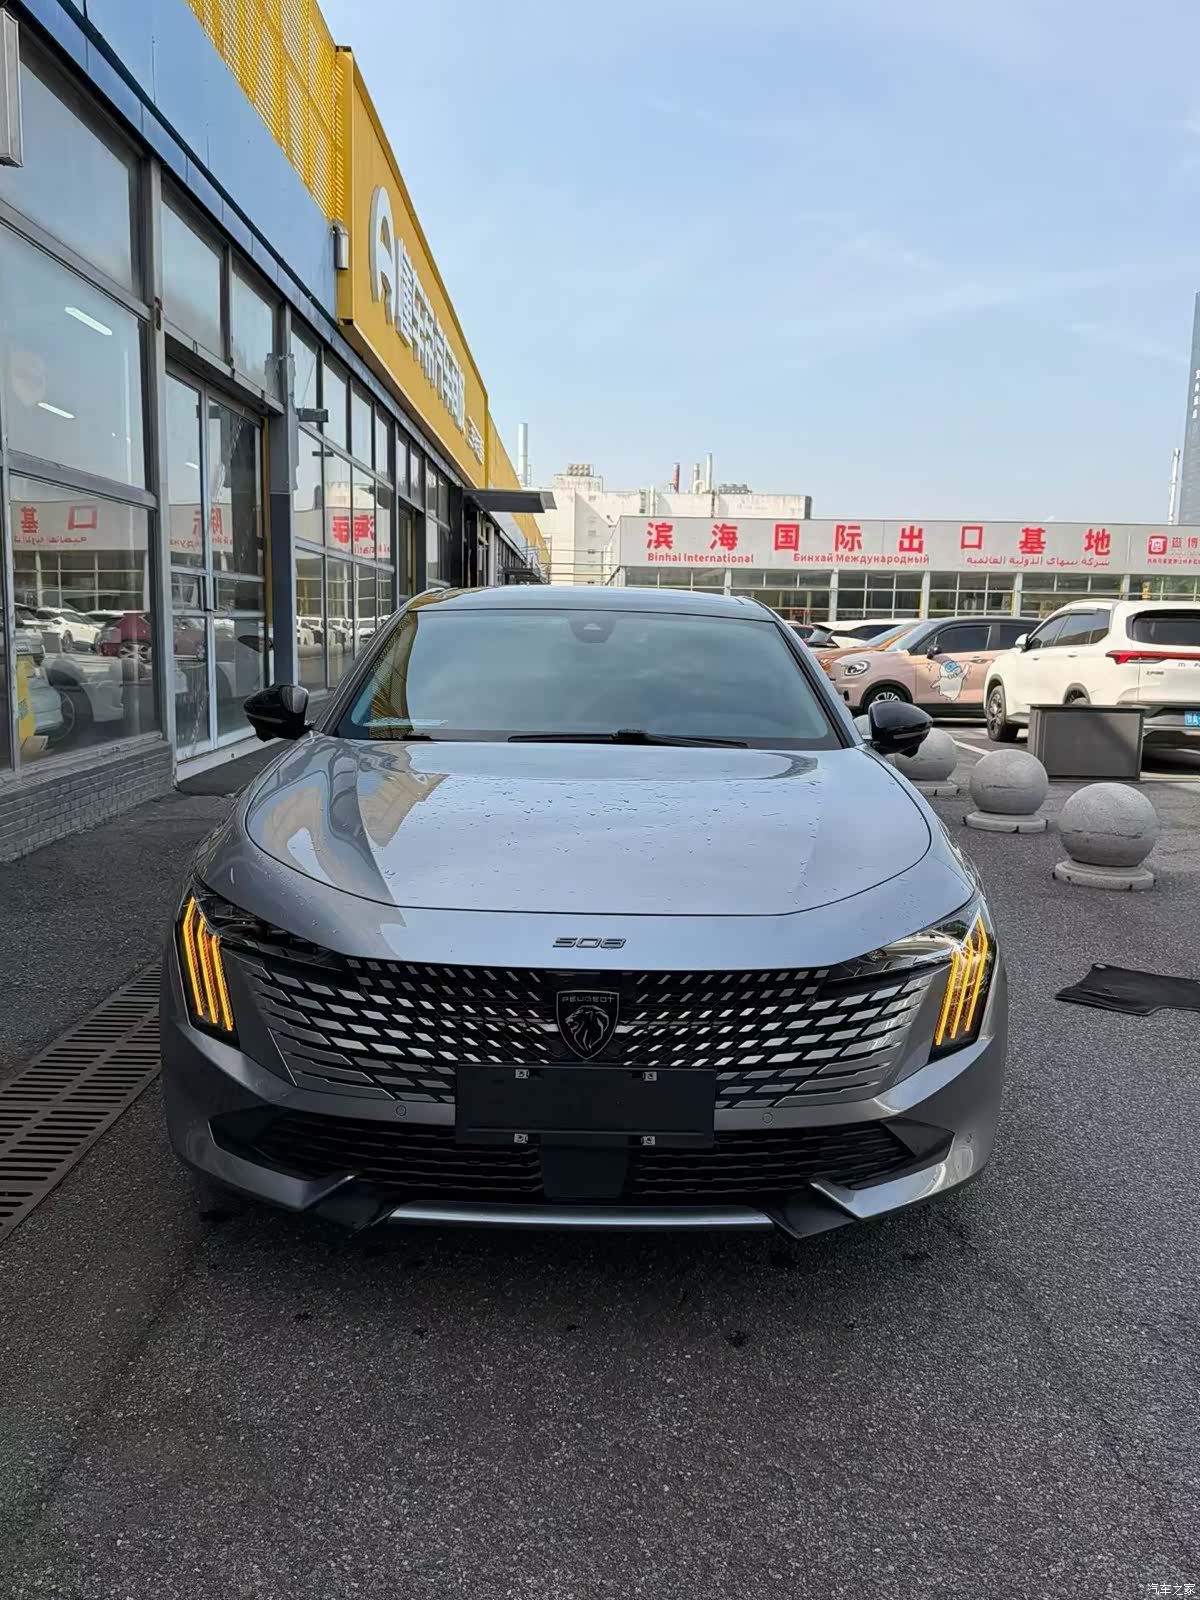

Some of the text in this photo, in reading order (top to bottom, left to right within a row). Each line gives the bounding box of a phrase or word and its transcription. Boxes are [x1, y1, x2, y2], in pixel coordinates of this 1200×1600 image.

[648, 552, 754, 563] Binhai International
[793, 552, 929, 565] Бинхай Международный
[552, 937, 627, 949] 508
[562, 995, 615, 1003] PEUGEOT
